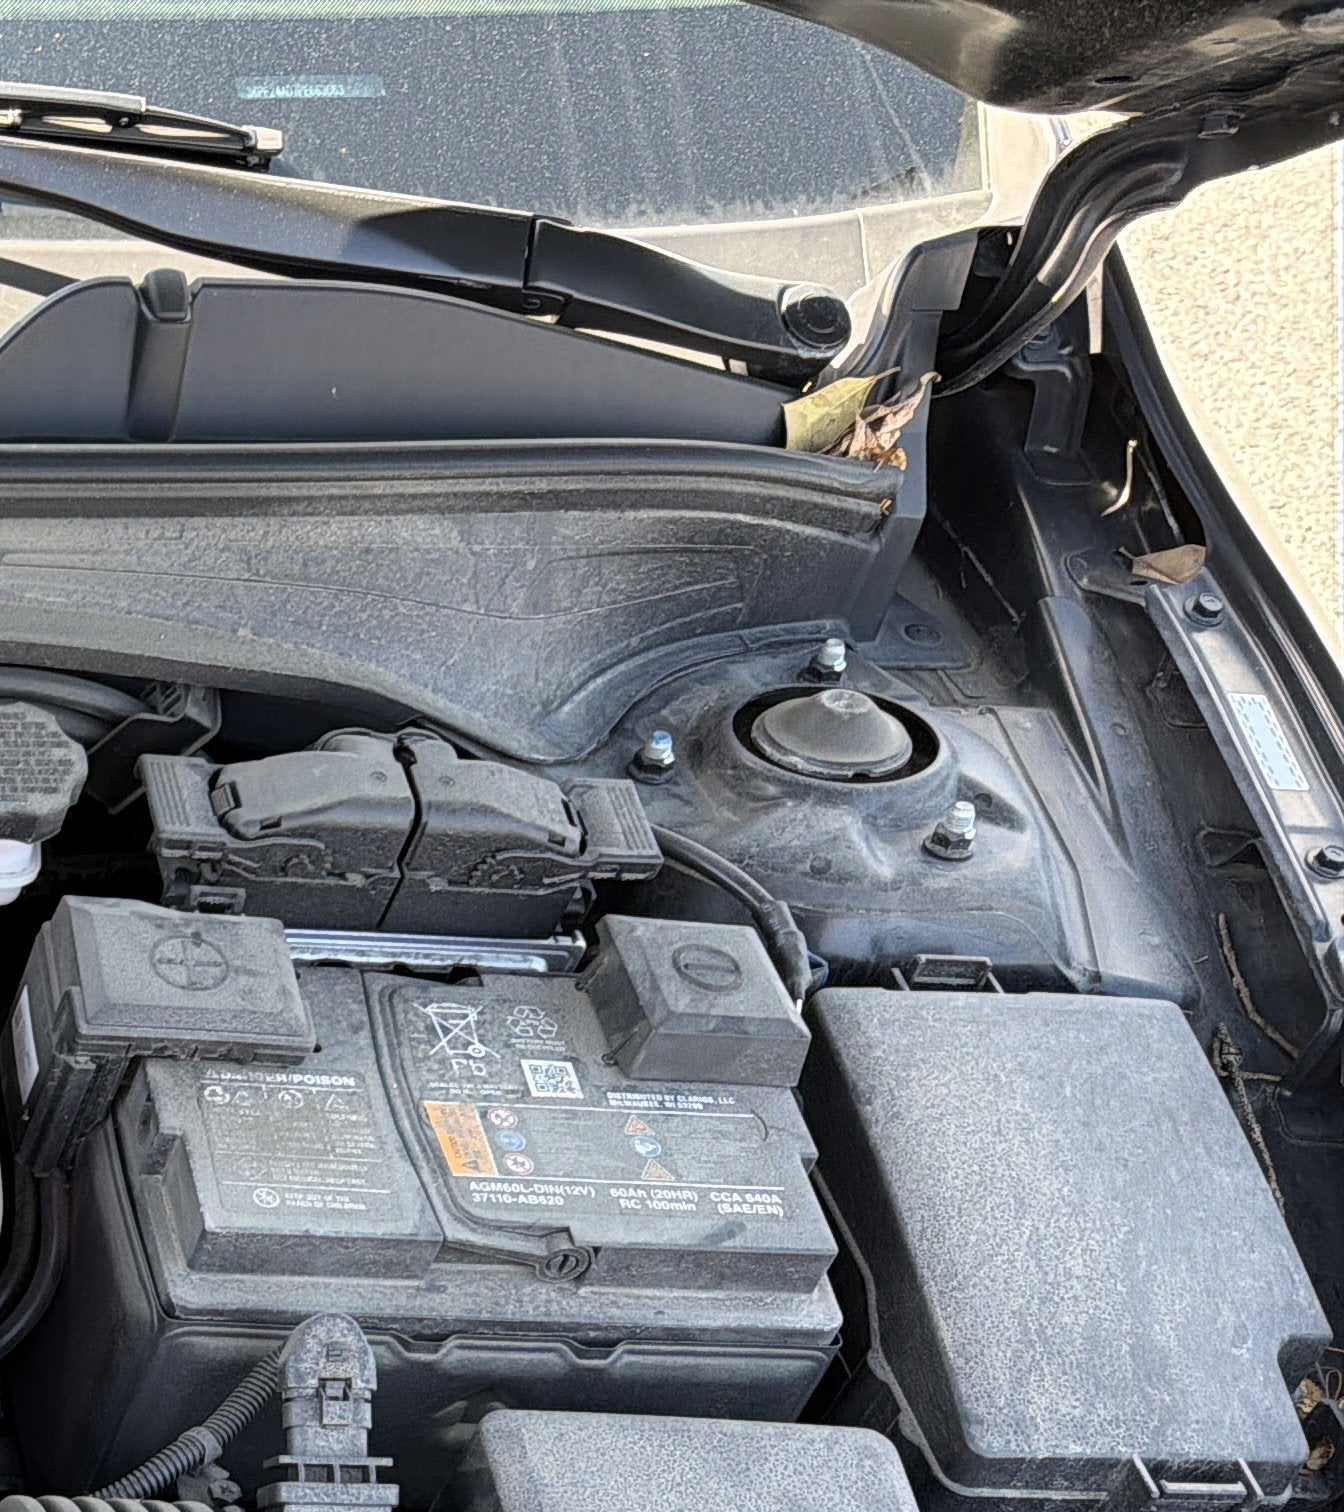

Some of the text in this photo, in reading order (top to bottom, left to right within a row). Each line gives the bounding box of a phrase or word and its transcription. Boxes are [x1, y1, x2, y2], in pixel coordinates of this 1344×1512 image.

[450, 1058, 487, 1077] Pb
[469, 1181, 596, 1198] AGM60L-DIN(12V)
[609, 1187, 699, 1202] 60Ah (20HR)
[709, 1191, 742, 1203] CCA
[618, 1199, 697, 1212] RC 100min
[717, 1203, 784, 1217] (SAE/EN)
